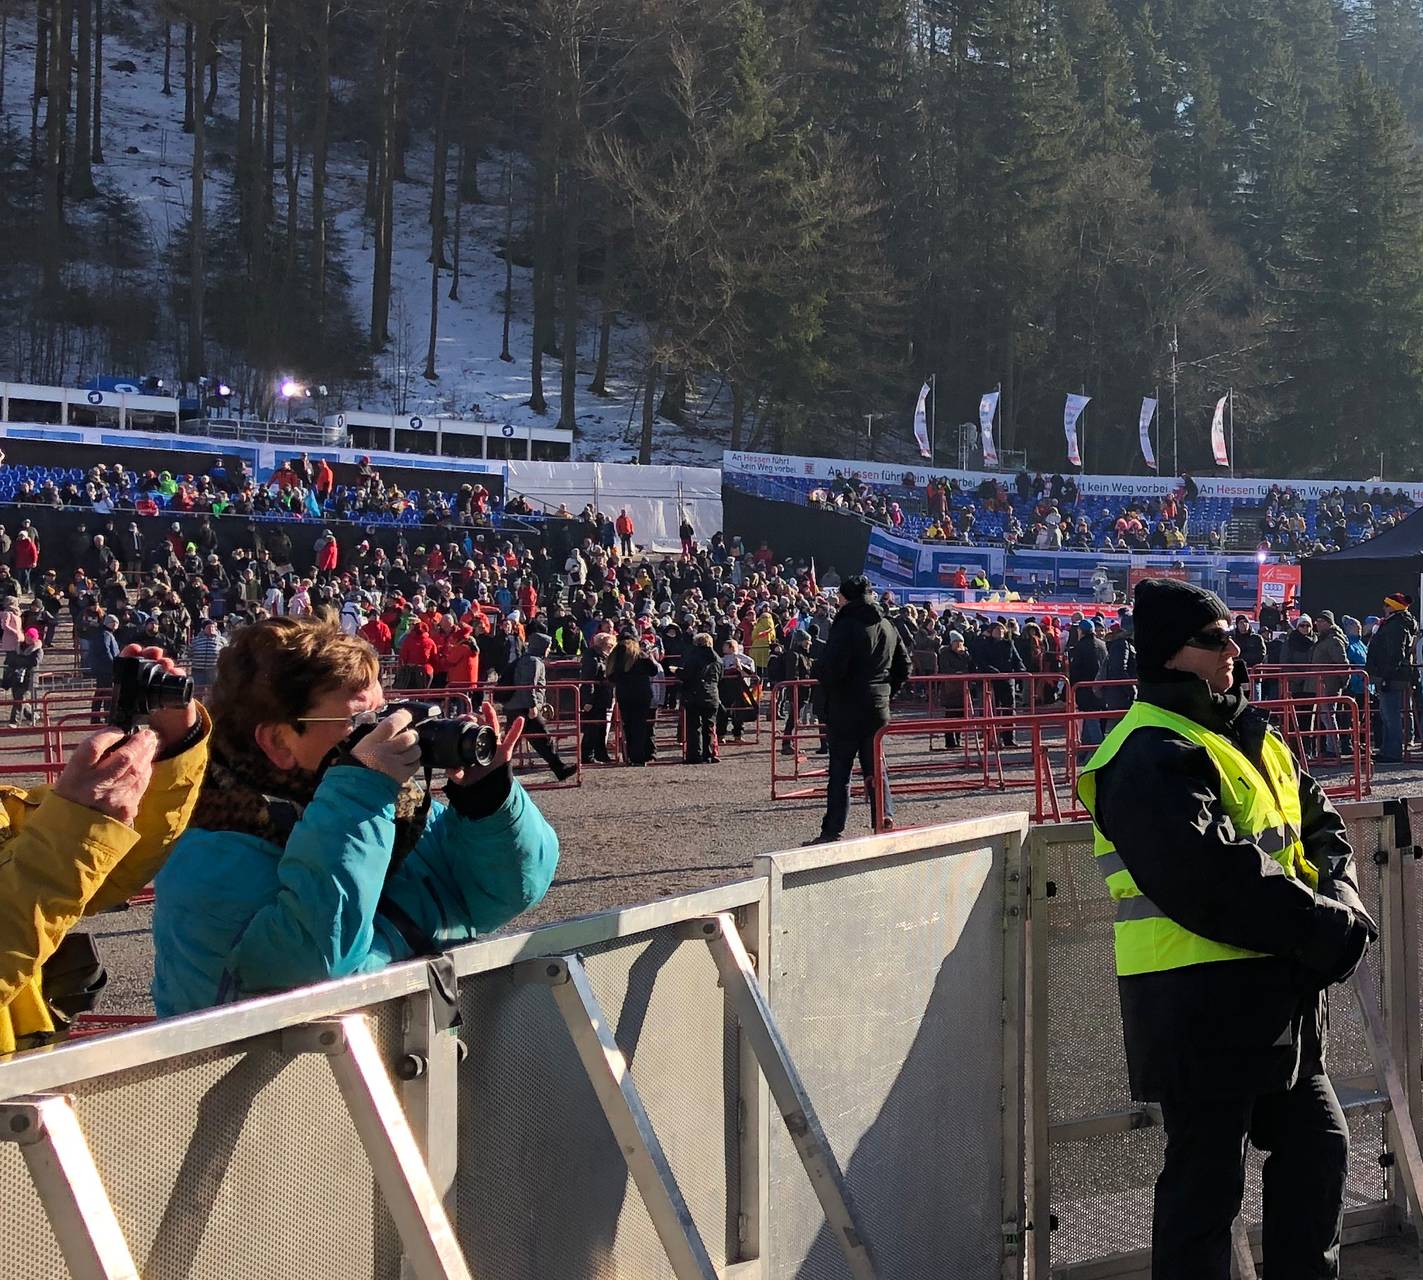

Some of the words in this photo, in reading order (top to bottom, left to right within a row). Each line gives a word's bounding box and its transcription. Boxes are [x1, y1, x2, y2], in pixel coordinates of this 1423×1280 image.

[731, 453, 742, 461] An
[743, 454, 771, 464] Hessen
[771, 456, 790, 465] führt
[757, 463, 773, 473] Weg
[844, 467, 880, 480] Hssen
[1087, 478, 1110, 491] kein
[1111, 478, 1134, 494] Weg
[1200, 484, 1214, 495] An
[1216, 484, 1255, 496] Hessen
